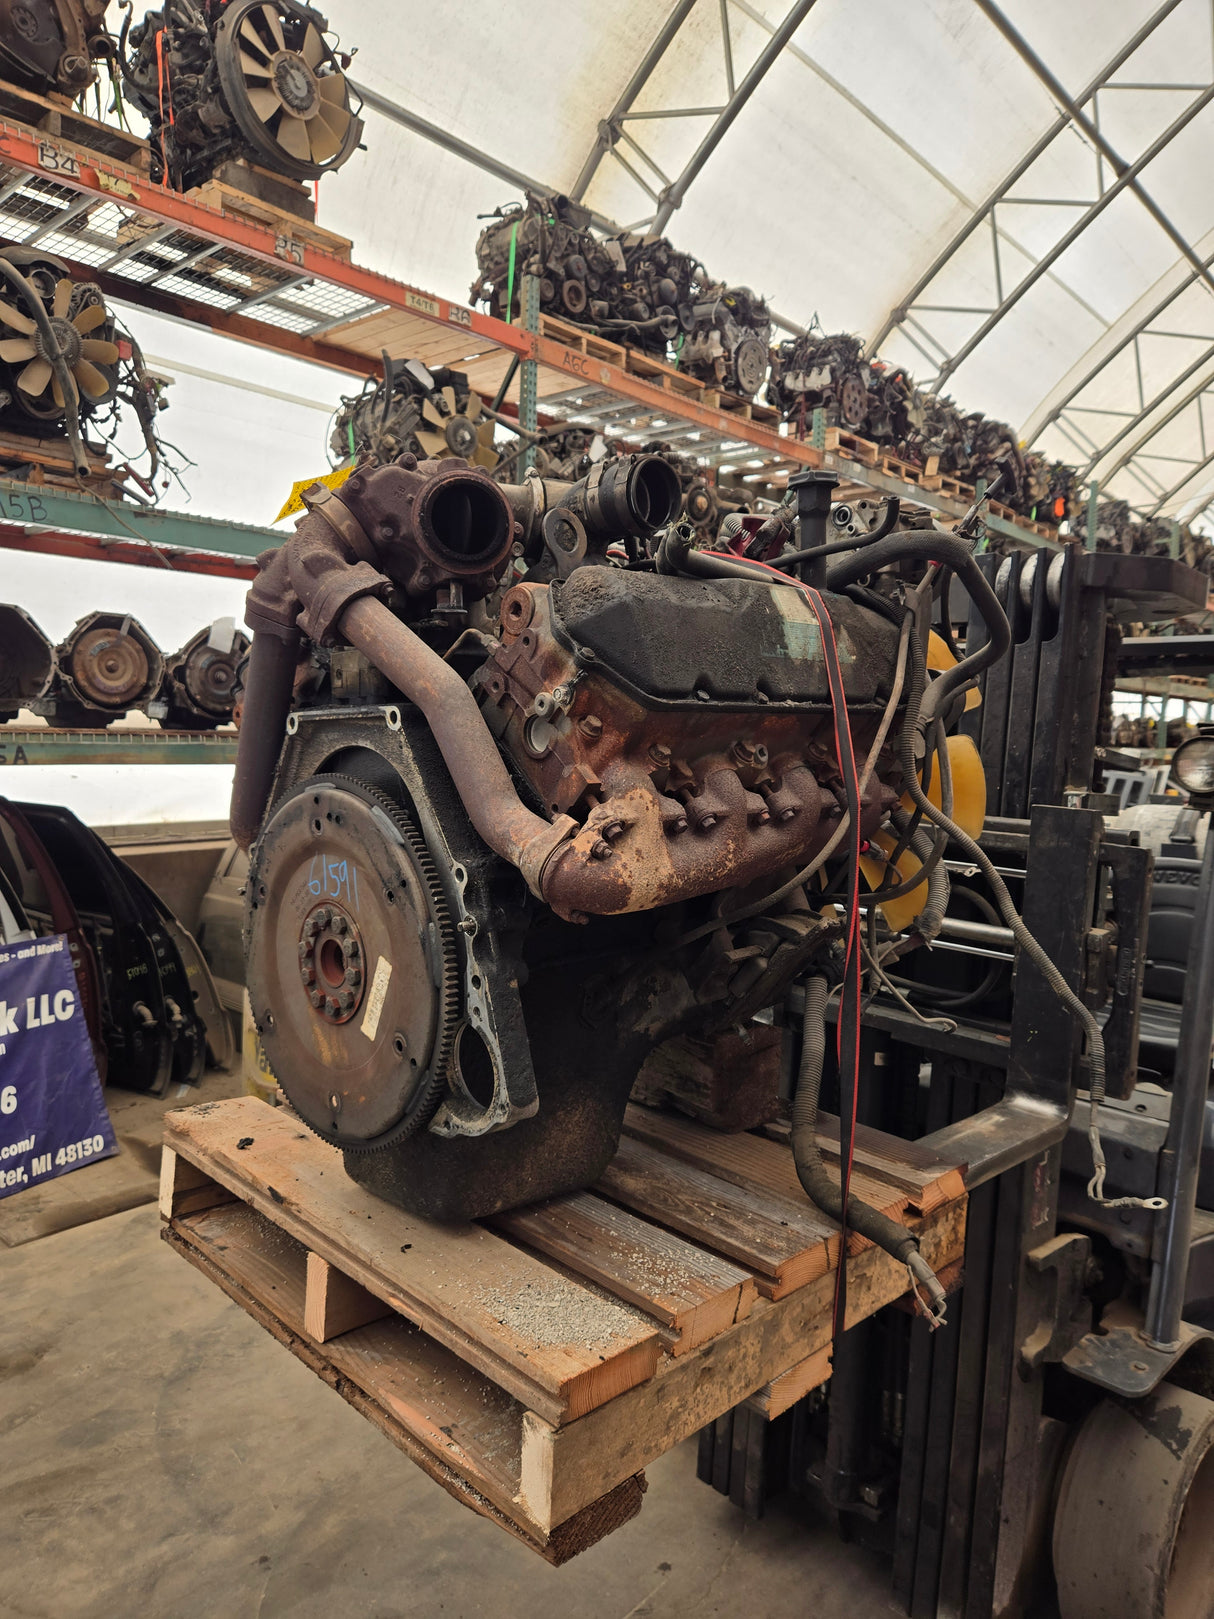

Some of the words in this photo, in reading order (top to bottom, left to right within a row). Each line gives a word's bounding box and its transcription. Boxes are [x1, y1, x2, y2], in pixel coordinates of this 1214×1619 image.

[39, 142, 77, 174] B4
[308, 851, 359, 912] 61591
[17, 946, 36, 959] and
[26, 989, 75, 1030] LLC
[0, 1085, 17, 1115] 6
[31, 1153, 52, 1177] MI
[55, 1134, 104, 1166] 48130
